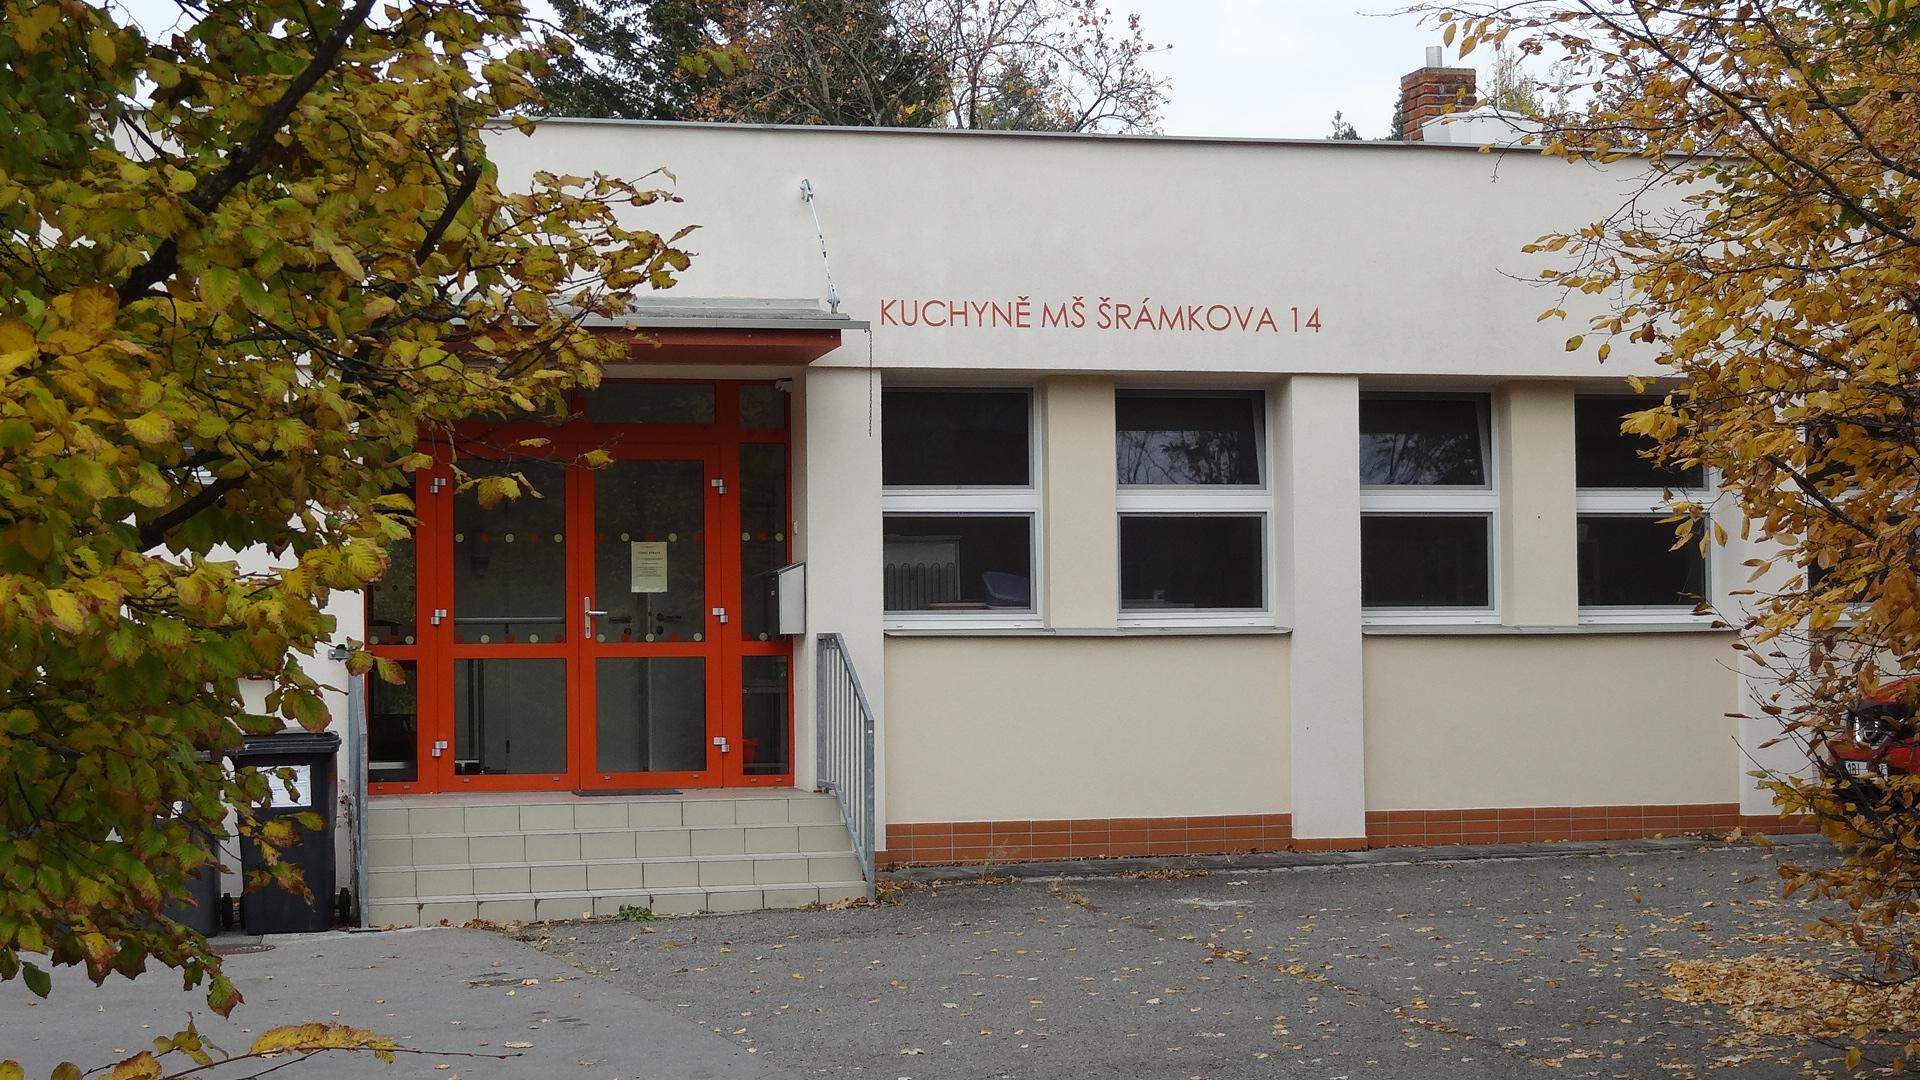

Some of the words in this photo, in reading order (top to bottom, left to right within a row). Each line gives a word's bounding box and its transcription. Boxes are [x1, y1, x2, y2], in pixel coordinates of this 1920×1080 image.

[880, 295, 1030, 328] KUCHYNĚ
[1041, 295, 1087, 330] MŠ
[1096, 295, 1278, 332] ŠRÁMKOVA
[1290, 306, 1322, 332] 14
